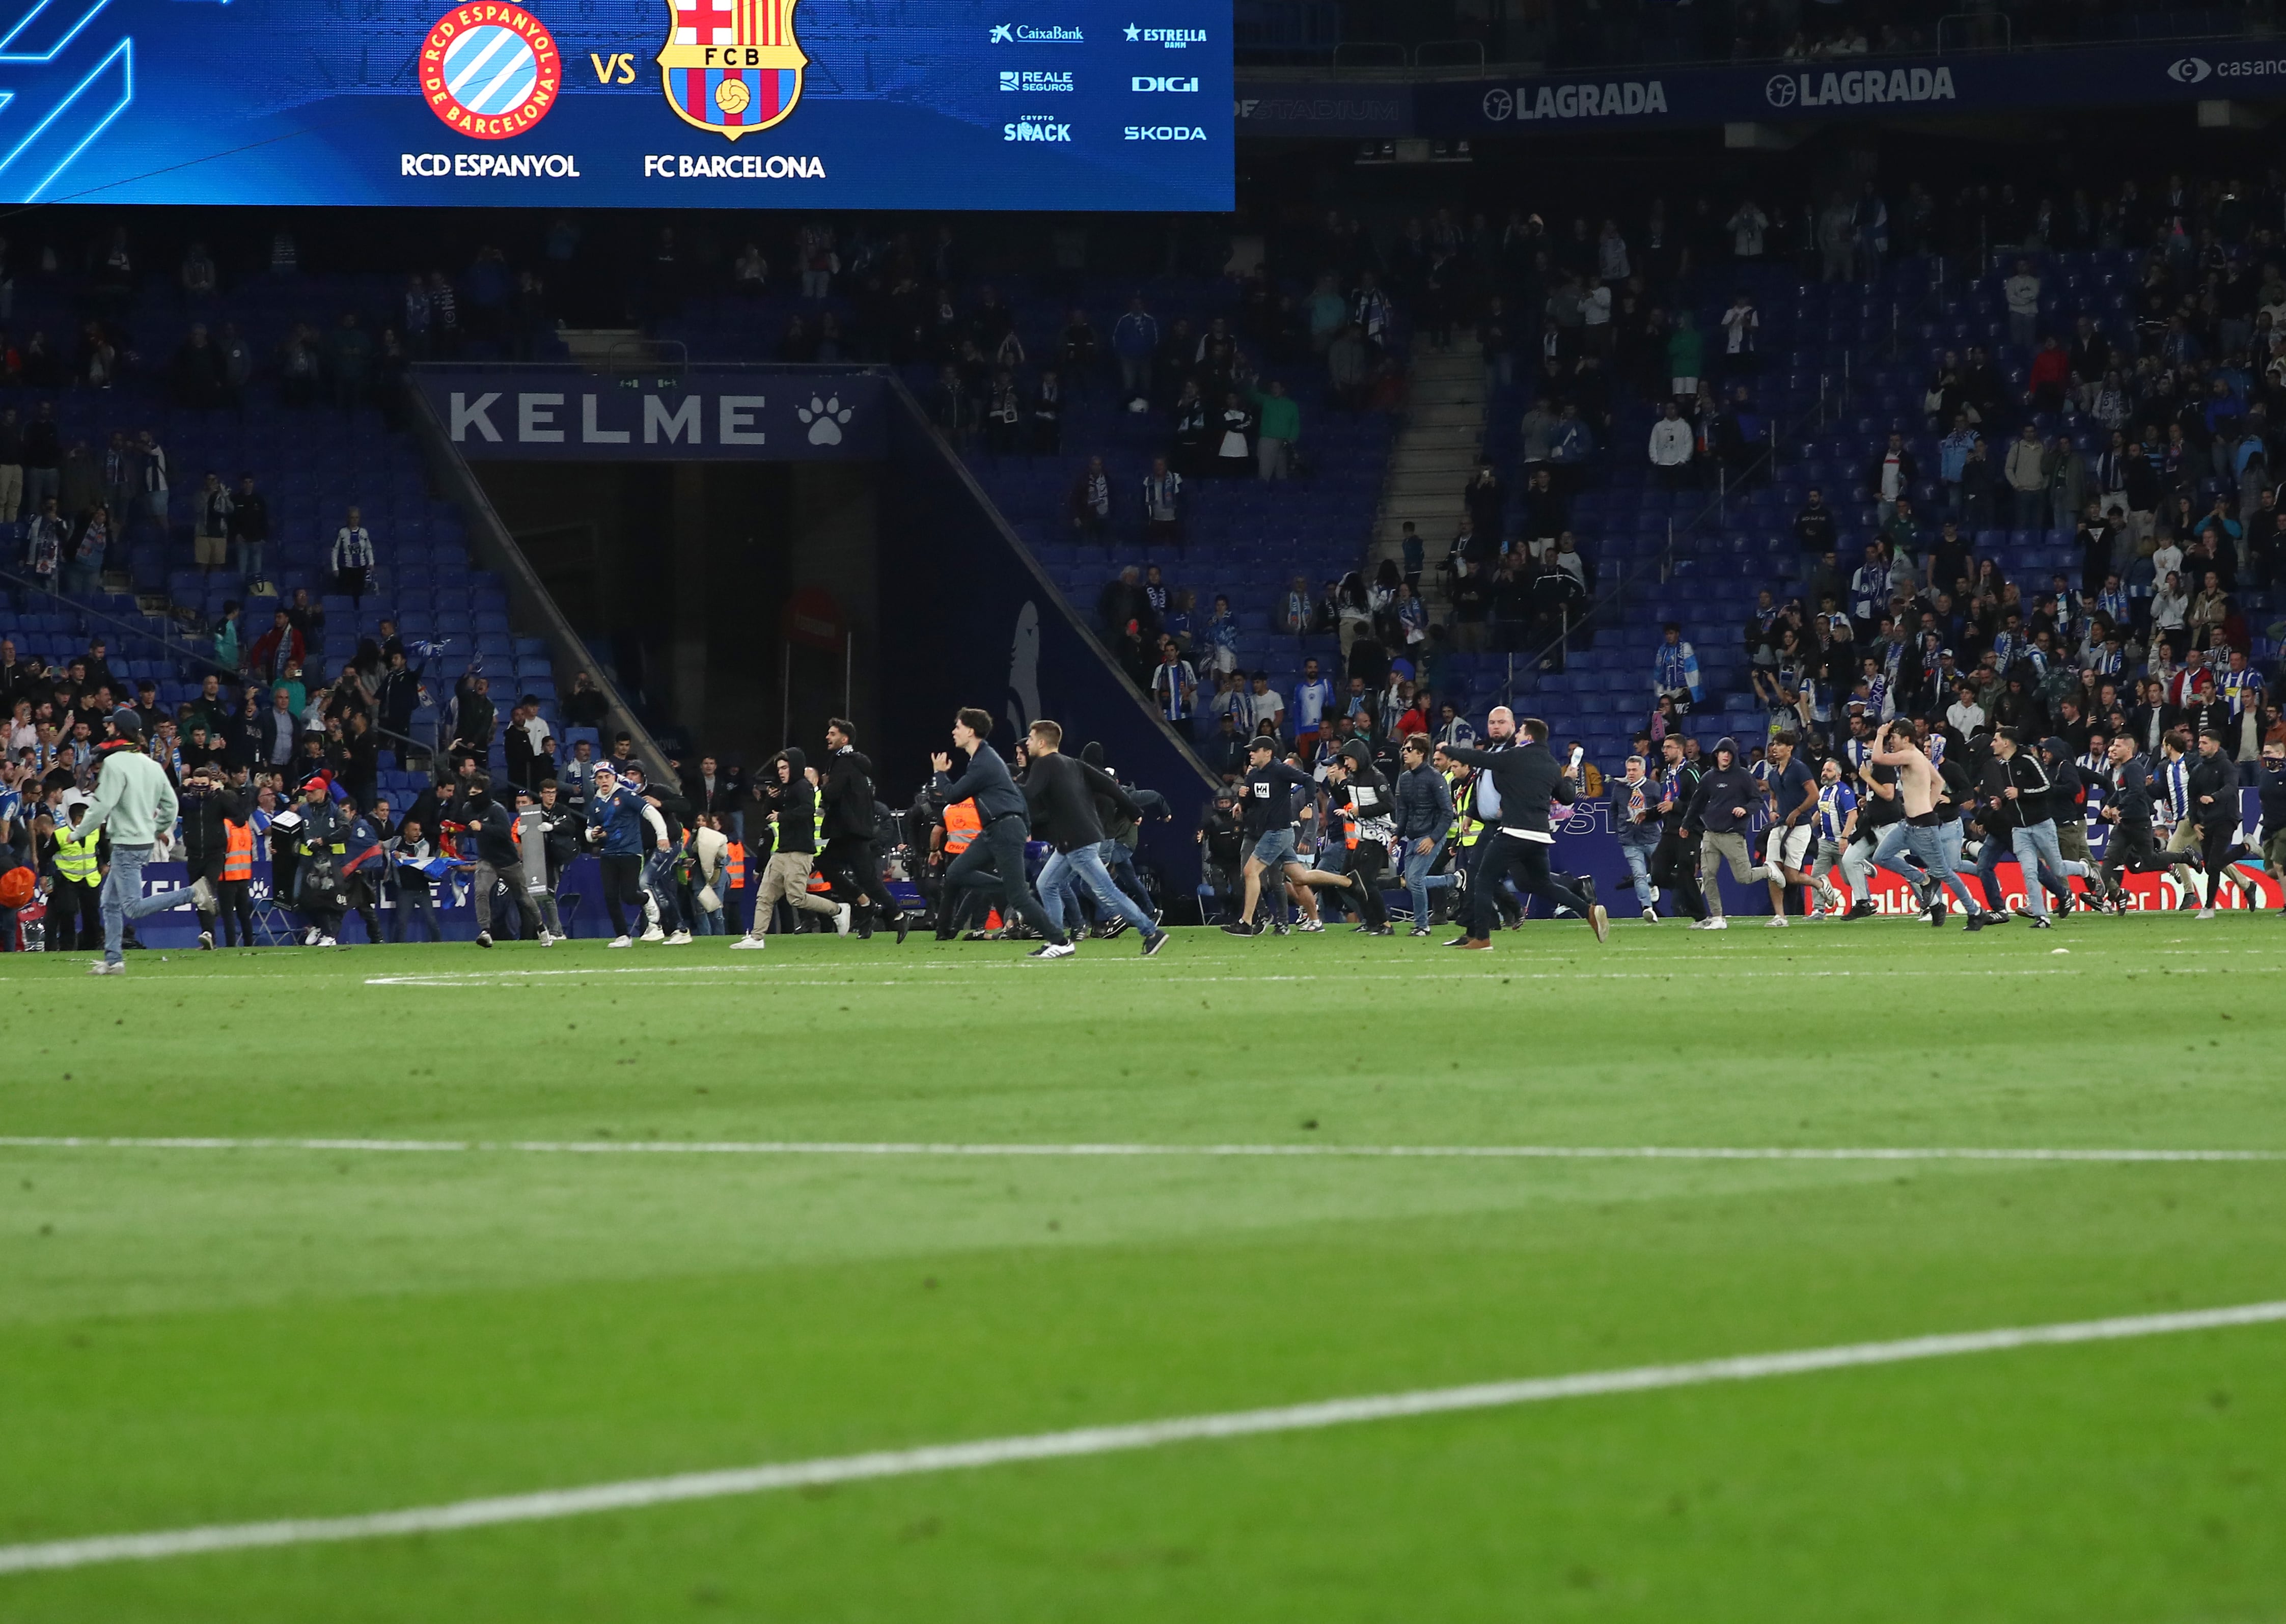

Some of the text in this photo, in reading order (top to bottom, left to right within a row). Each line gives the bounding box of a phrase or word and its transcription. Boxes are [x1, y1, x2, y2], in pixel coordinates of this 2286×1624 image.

[426, 6, 554, 63] RCD ESPANYOL
[1017, 25, 1084, 40] CaixaBank
[1144, 30, 1207, 42] ESTRELLA
[591, 53, 636, 85] VS
[705, 48, 759, 66] FCB
[1023, 72, 1073, 83] REALE
[1023, 84, 1074, 92] SEGUROS
[1132, 77, 1198, 92] DIGI
[1800, 66, 1956, 106] LAGRADA
[427, 77, 555, 134] DE BARCELONA
[1517, 80, 1668, 120] LAGRADA
[1124, 126, 1207, 141] SKODA
[402, 154, 580, 178] RCD ESPANYOL
[645, 155, 826, 179] FC BARCELONA
[450, 392, 765, 446] KELME
